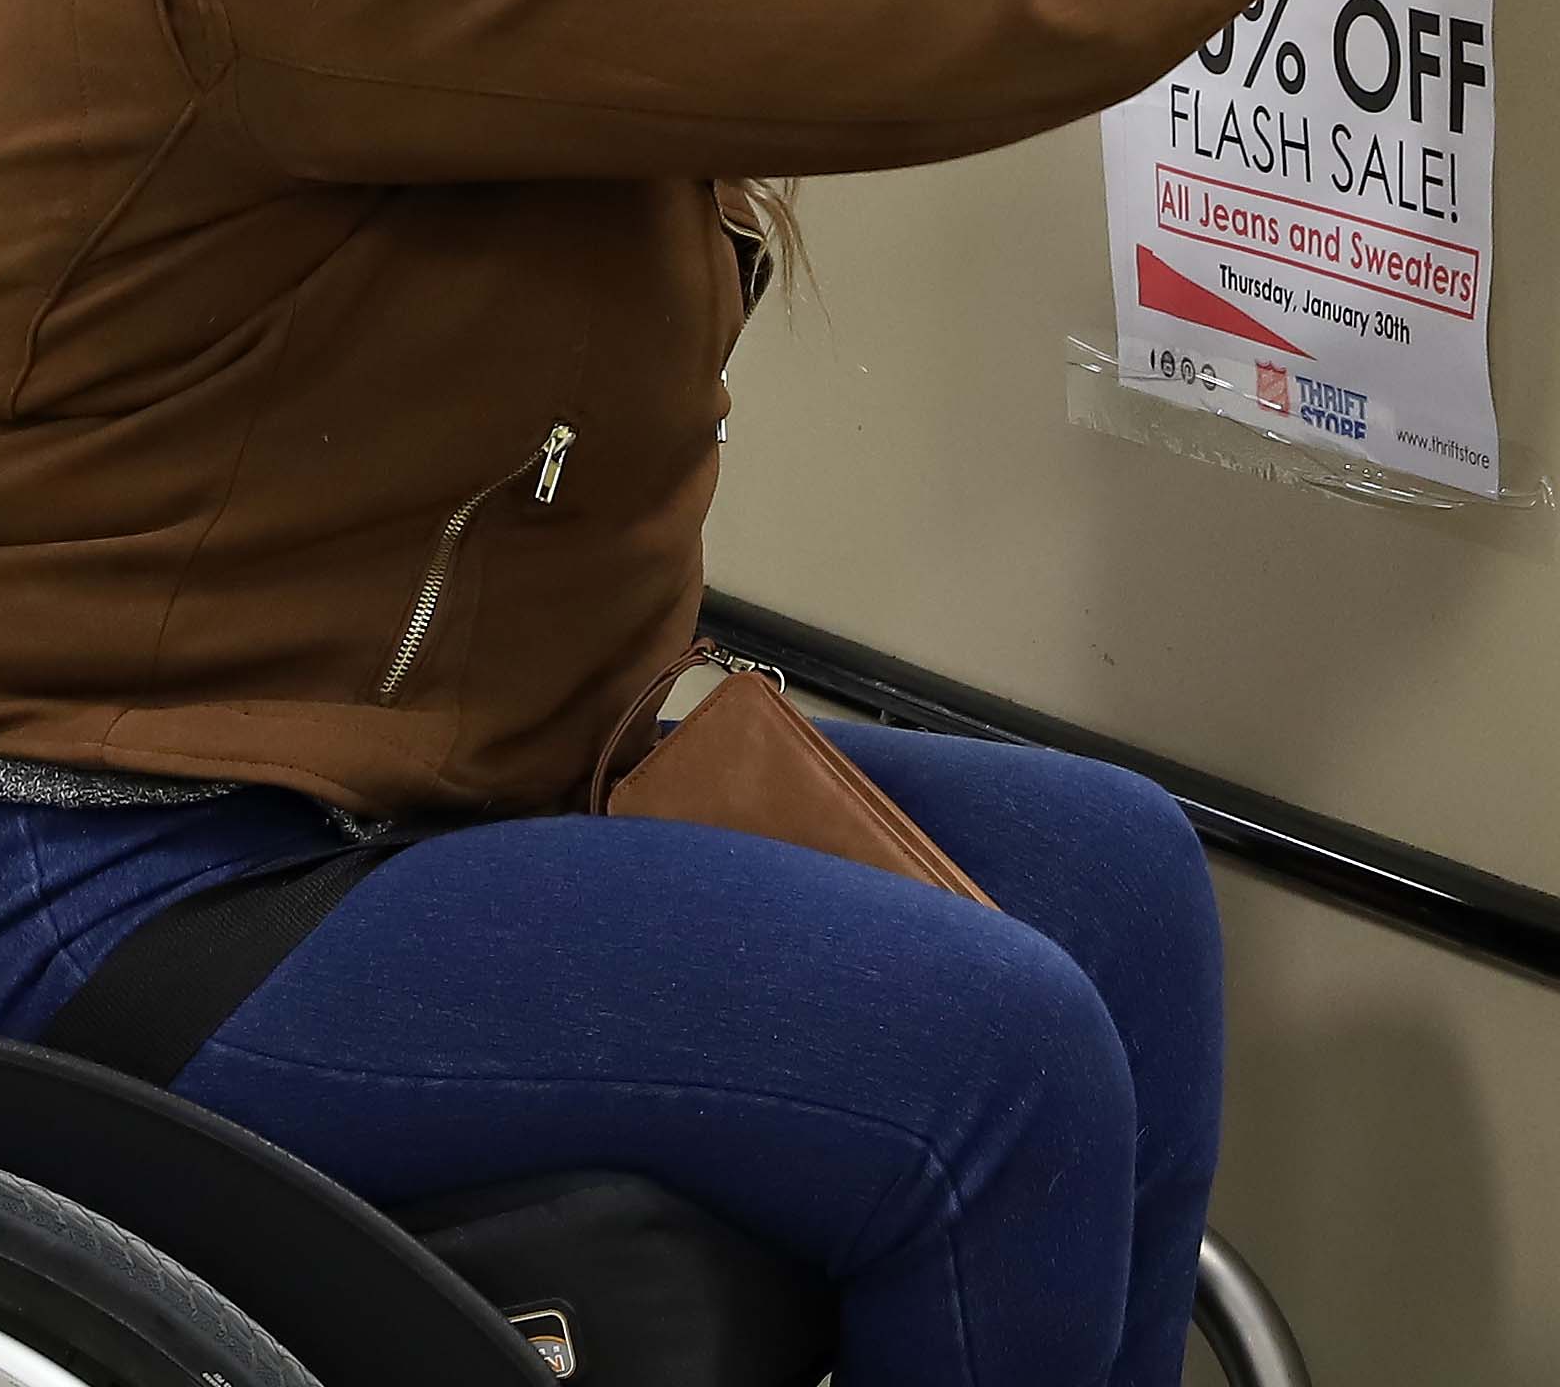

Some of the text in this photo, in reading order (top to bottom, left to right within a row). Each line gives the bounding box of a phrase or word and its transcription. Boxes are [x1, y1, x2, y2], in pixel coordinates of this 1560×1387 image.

[1170, 82, 1459, 225] FLASH SALE!
[1160, 180, 1473, 303] All Jeans and Sweaters
[1218, 263, 1412, 346] Thursday, January 30th
[1295, 375, 1368, 419] THRIFT
[1299, 407, 1366, 441] STORE
[1396, 427, 1491, 471] www.thriftstore
